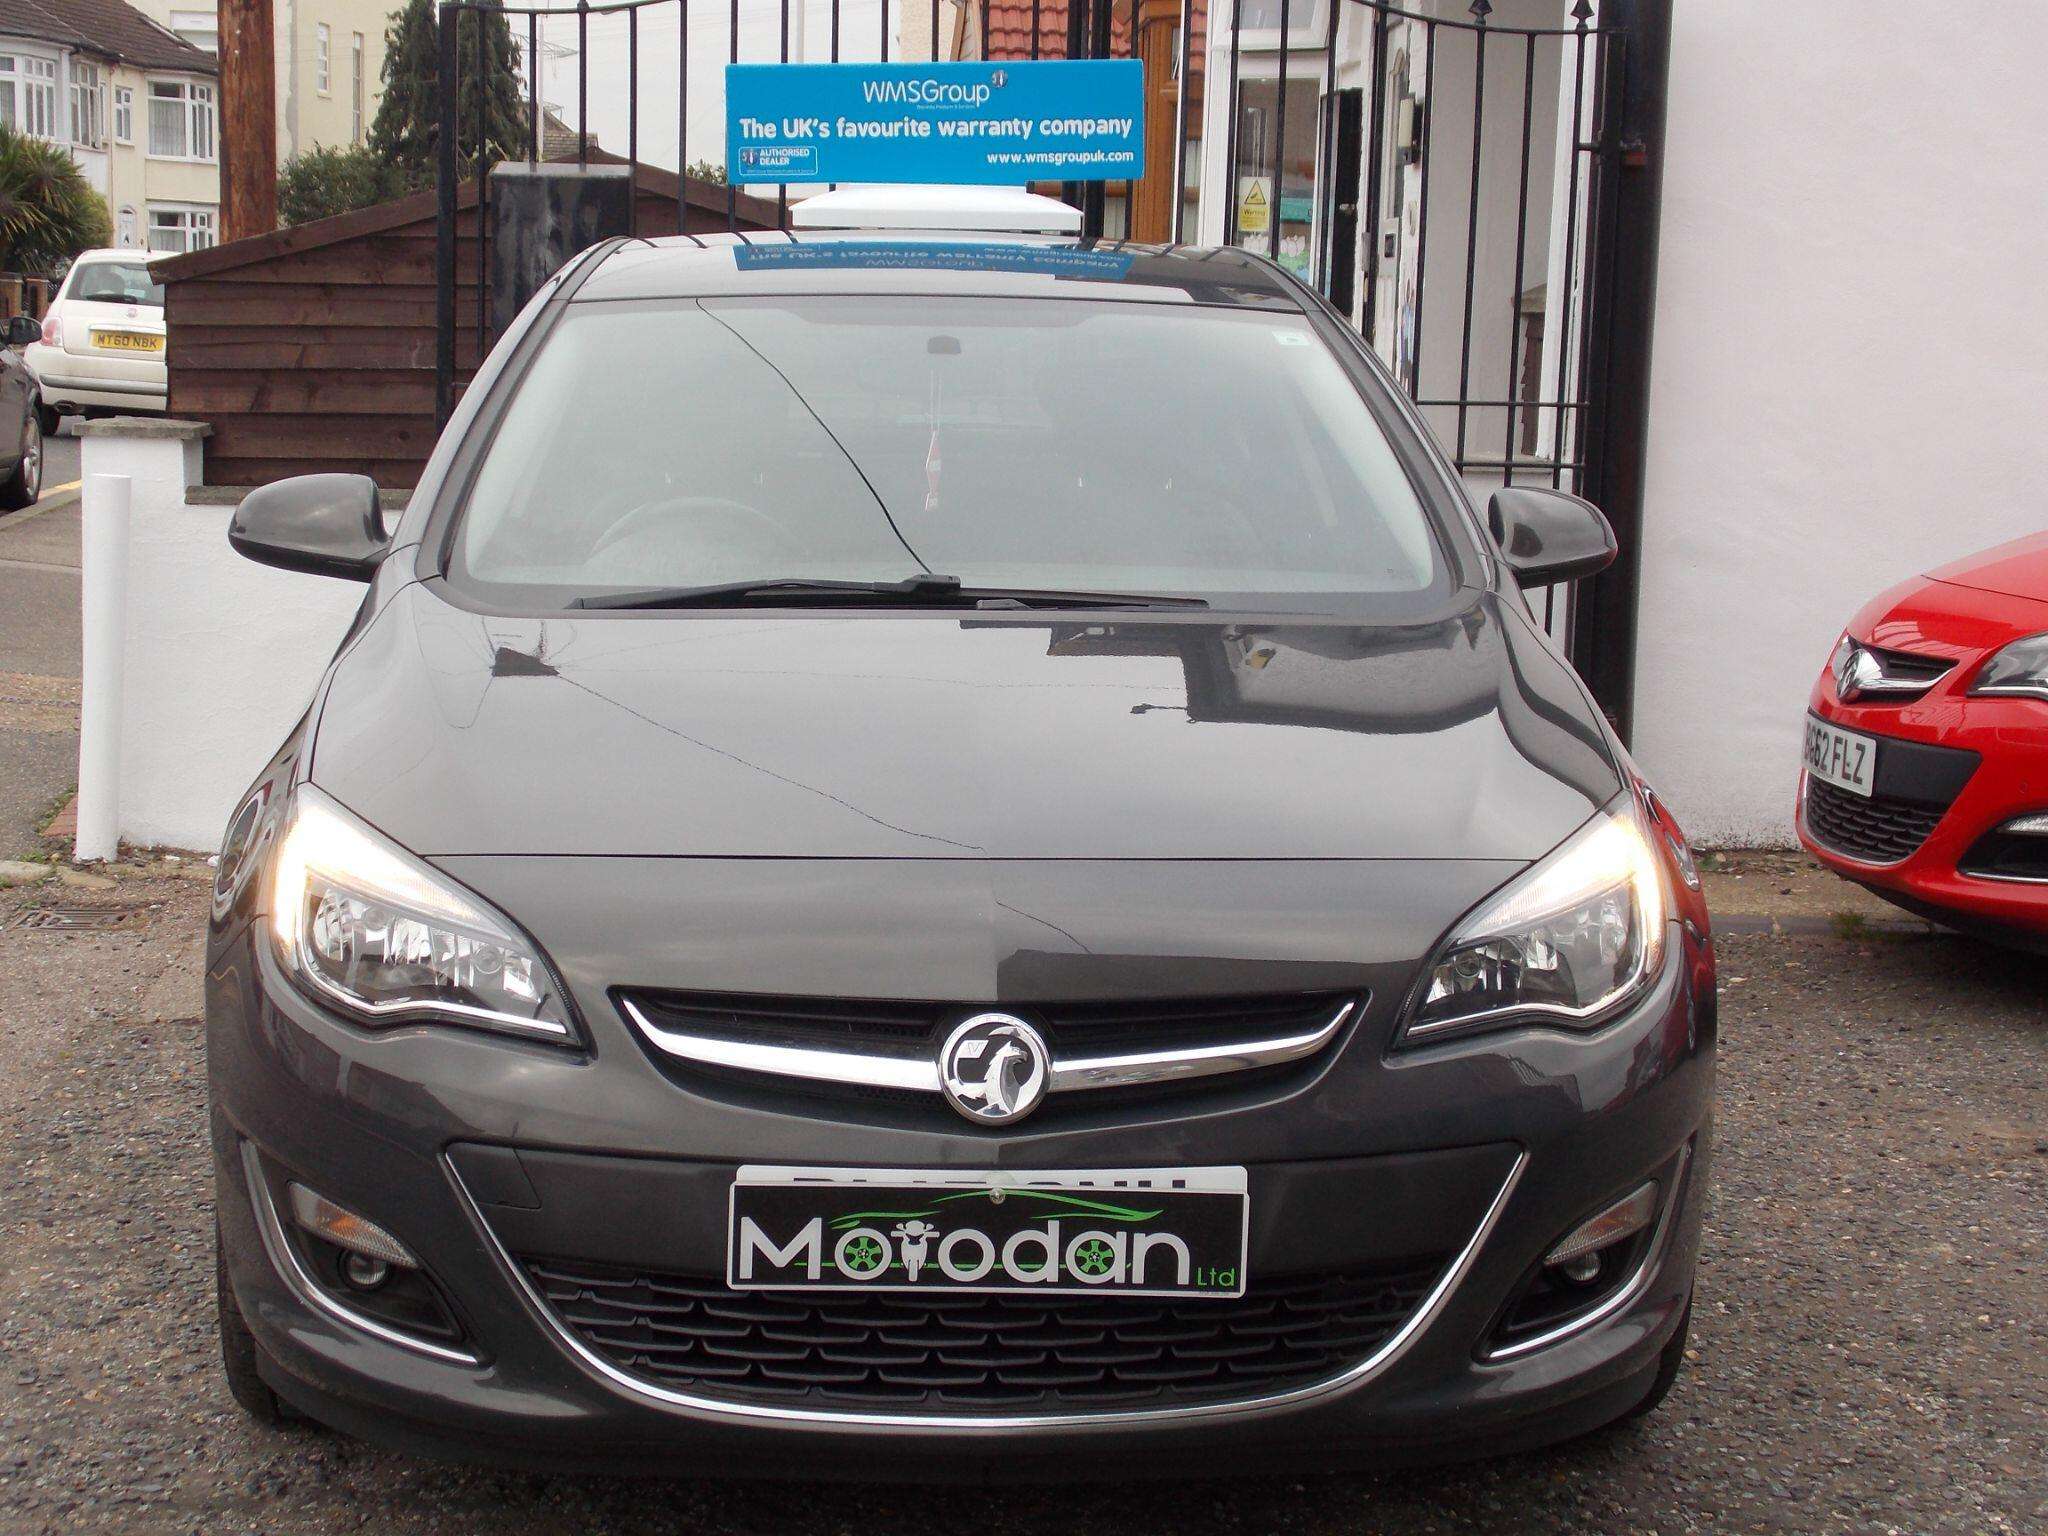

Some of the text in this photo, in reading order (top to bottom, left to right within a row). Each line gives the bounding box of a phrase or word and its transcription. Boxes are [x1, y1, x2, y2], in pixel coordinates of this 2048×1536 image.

[863, 80, 990, 107] WMSGroup
[739, 116, 1133, 140] The UK's favourite warranty company
[760, 148, 810, 157] AUTHORISED
[760, 157, 790, 166] DEALER
[987, 150, 1134, 166] www.wmsgroupuk.com
[1831, 735, 1866, 785] FLZ
[740, 1217, 1235, 1287] Motodan Ltd
